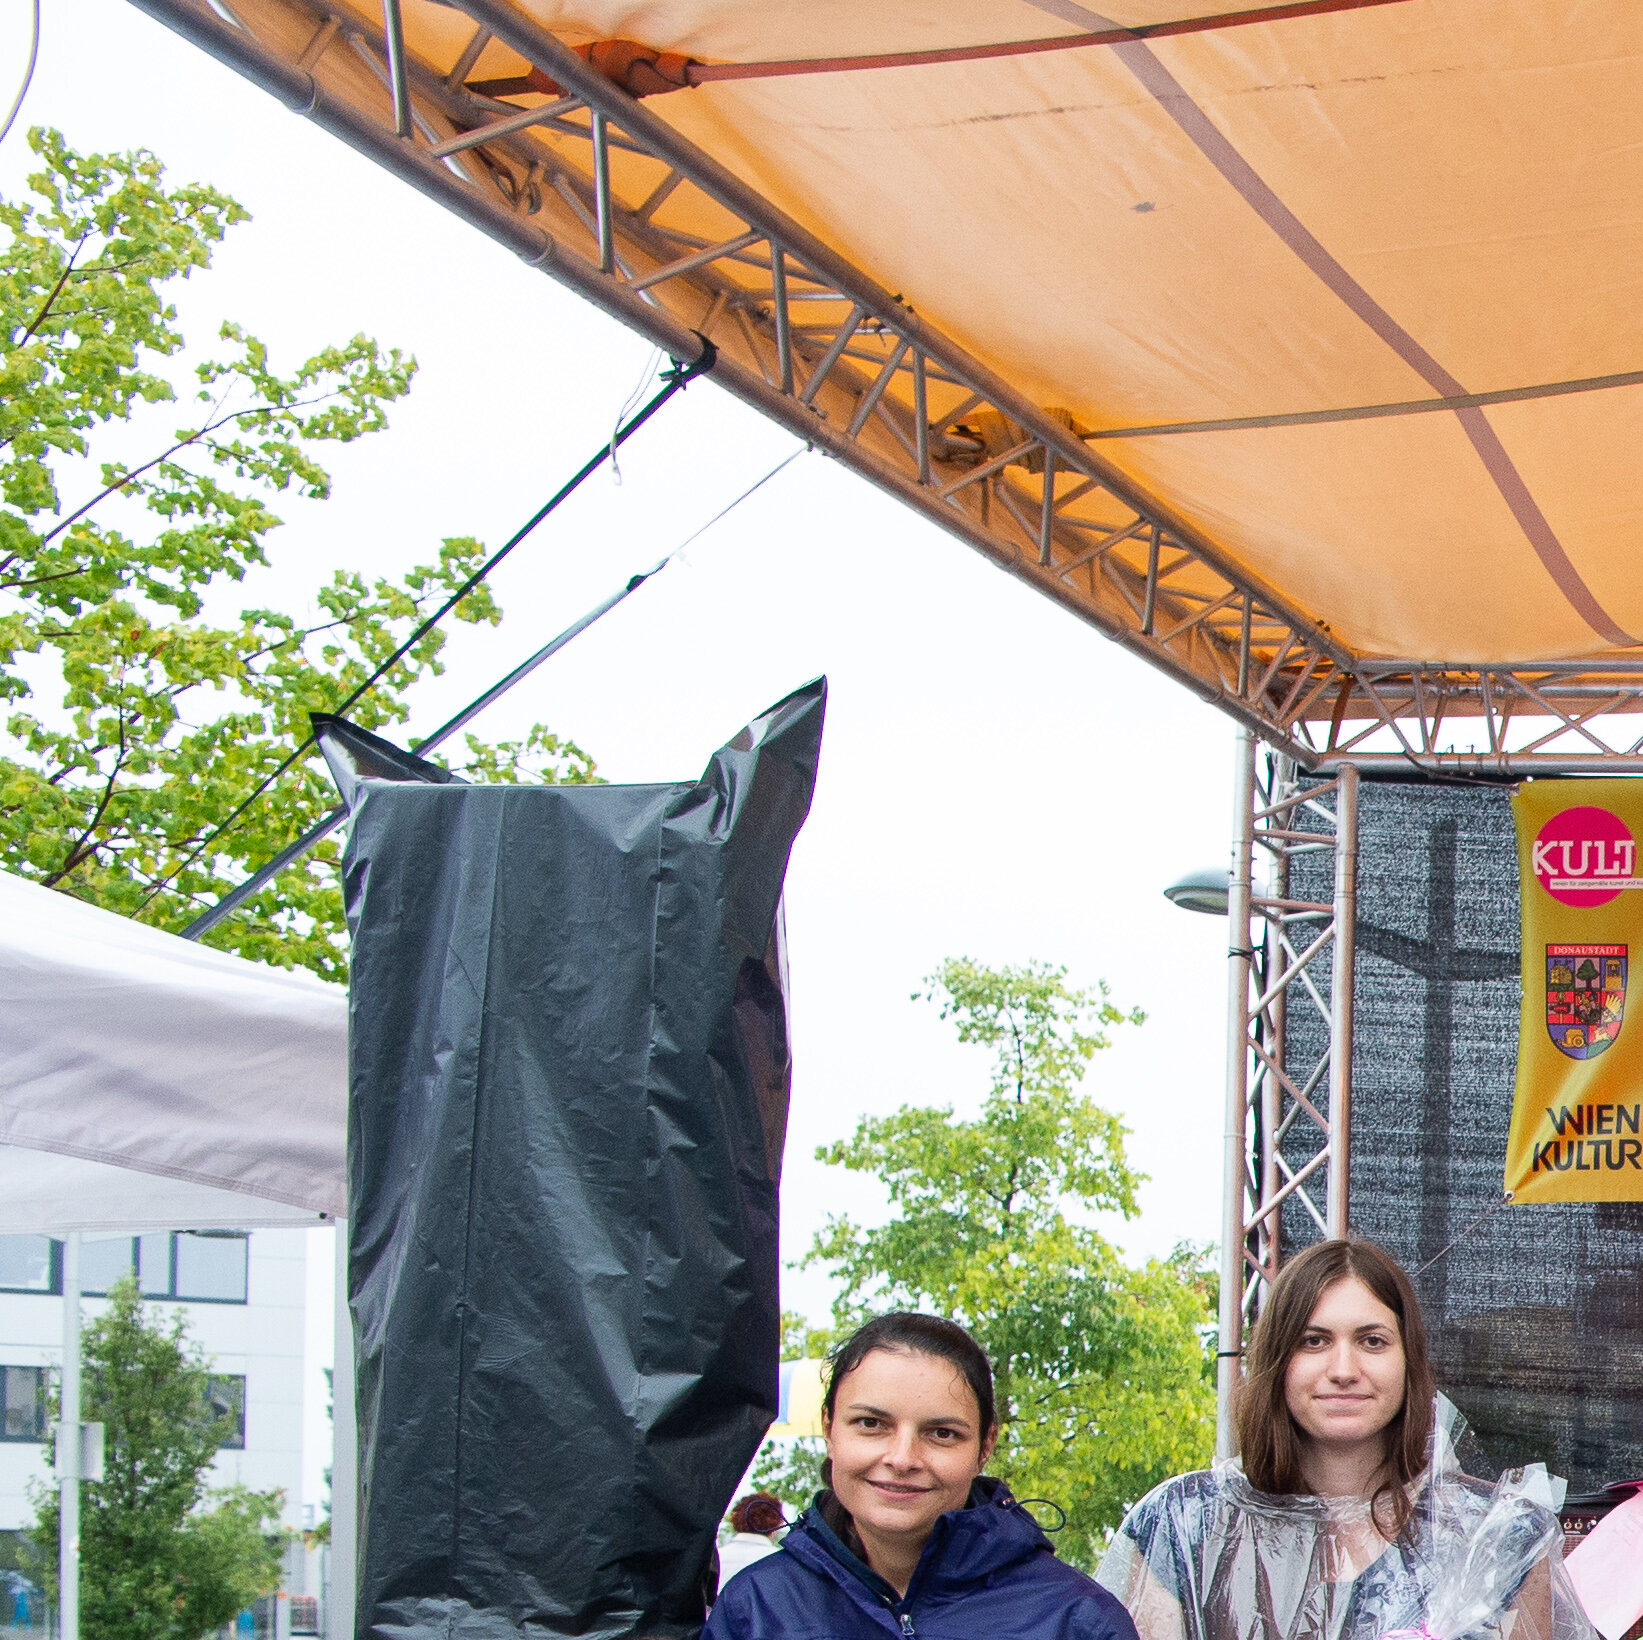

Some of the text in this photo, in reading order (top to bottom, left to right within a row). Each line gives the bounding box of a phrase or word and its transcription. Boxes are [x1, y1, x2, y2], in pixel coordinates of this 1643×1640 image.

[1532, 839, 1636, 876] KULT
[1545, 1103, 1641, 1136] WIEN
[1531, 1138, 1643, 1172] KULTUR
